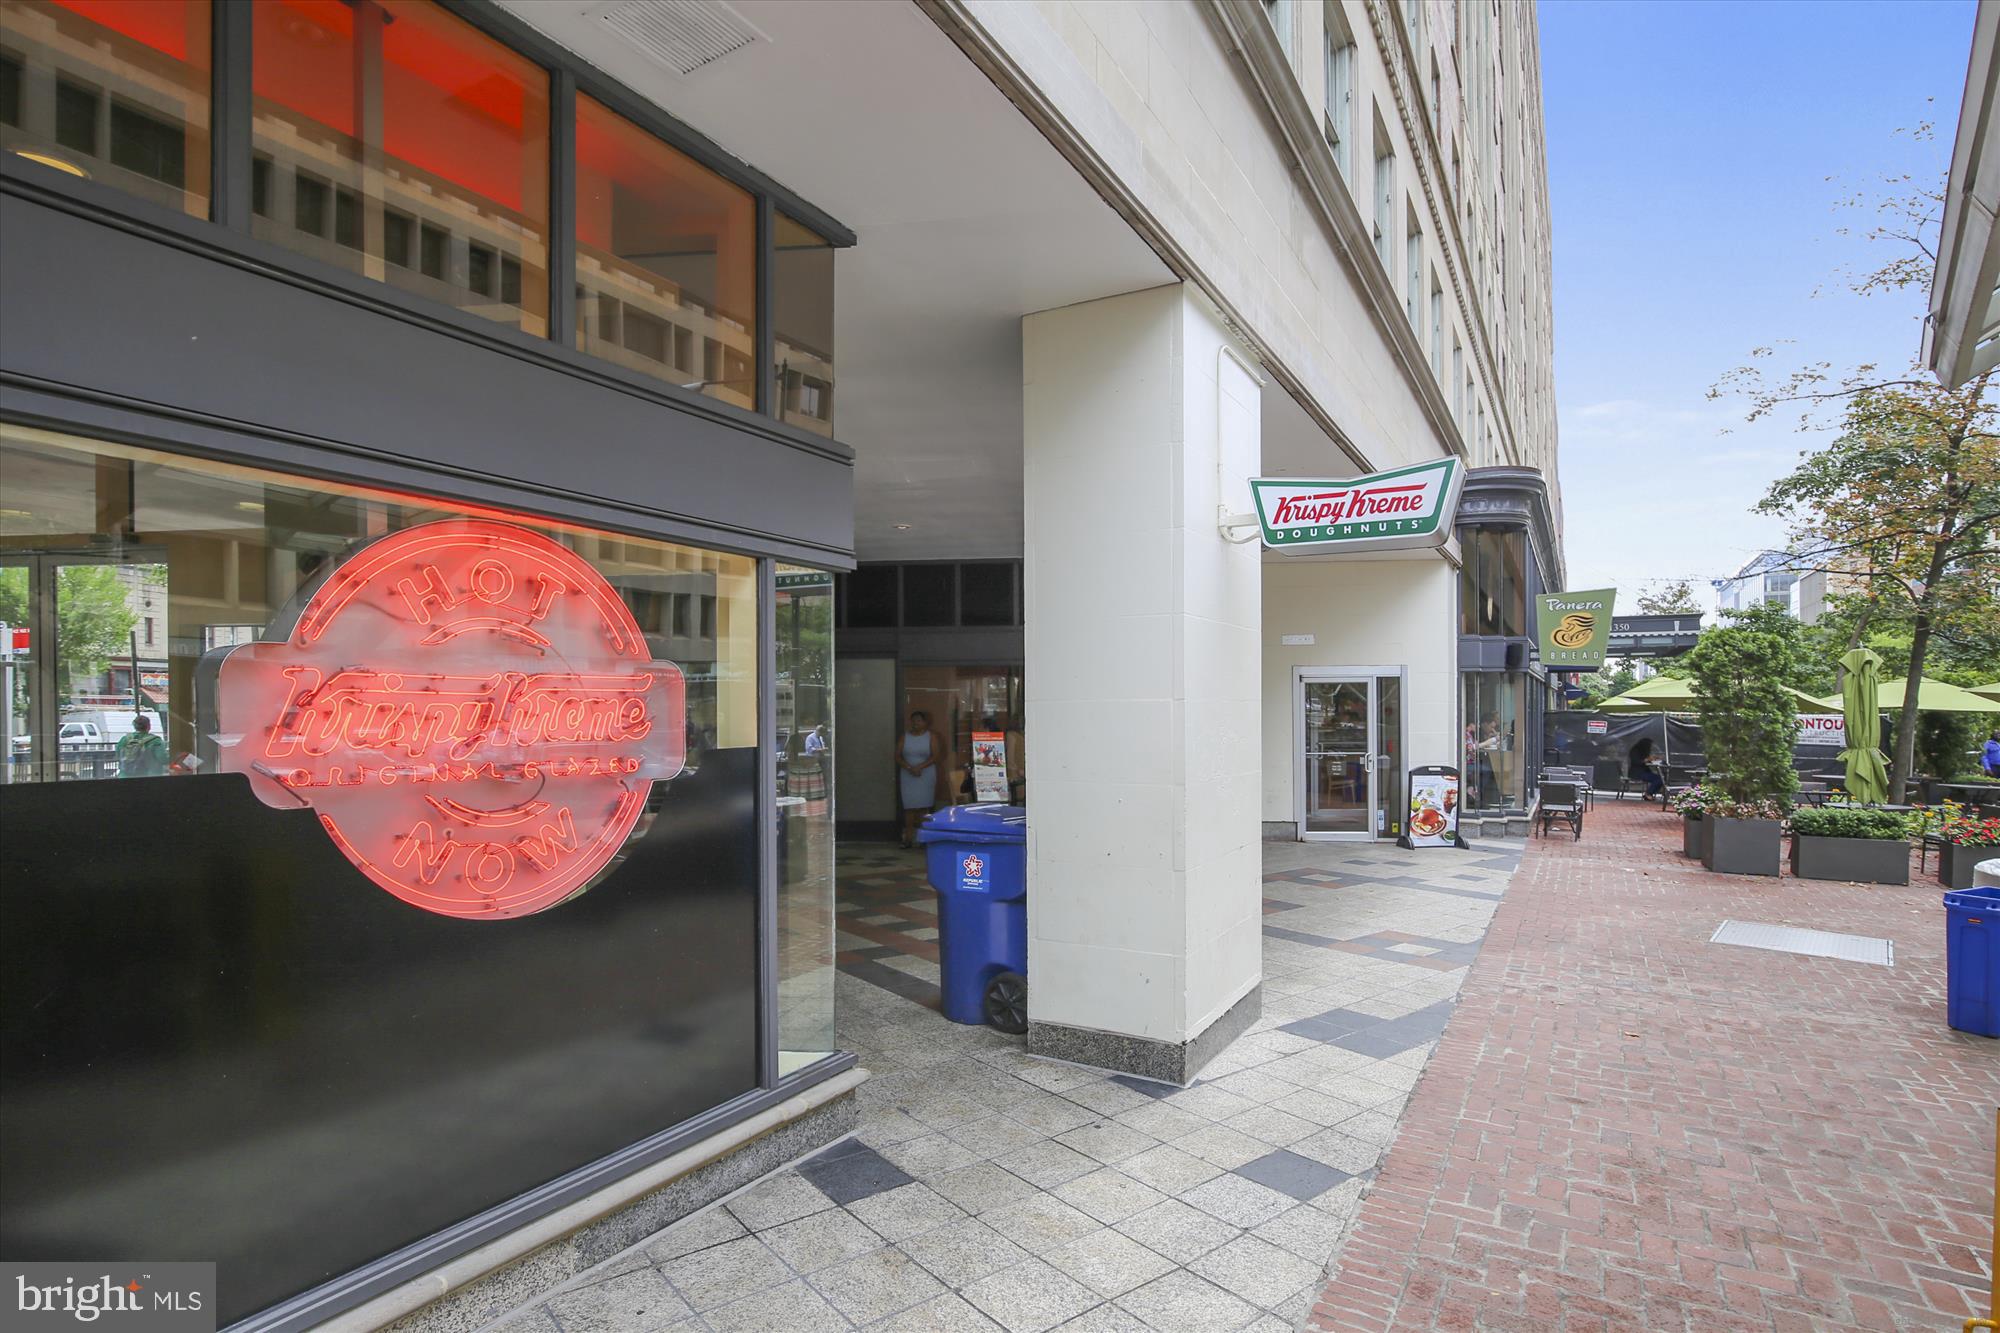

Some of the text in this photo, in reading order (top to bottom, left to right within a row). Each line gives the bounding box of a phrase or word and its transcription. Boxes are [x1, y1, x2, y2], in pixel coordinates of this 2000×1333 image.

[1272, 482, 1428, 525] Krispy Kreme
[1276, 519, 1419, 540] DOUGHNUTS
[397, 558, 567, 626] HOT
[1545, 598, 1604, 612] Panera
[1550, 651, 1601, 661] BREAD
[265, 667, 653, 762] Krispy Kreme
[1793, 717, 1845, 731] ONTOU
[287, 757, 640, 788] ORIGINAL GLAZED
[392, 806, 579, 895] NOW
